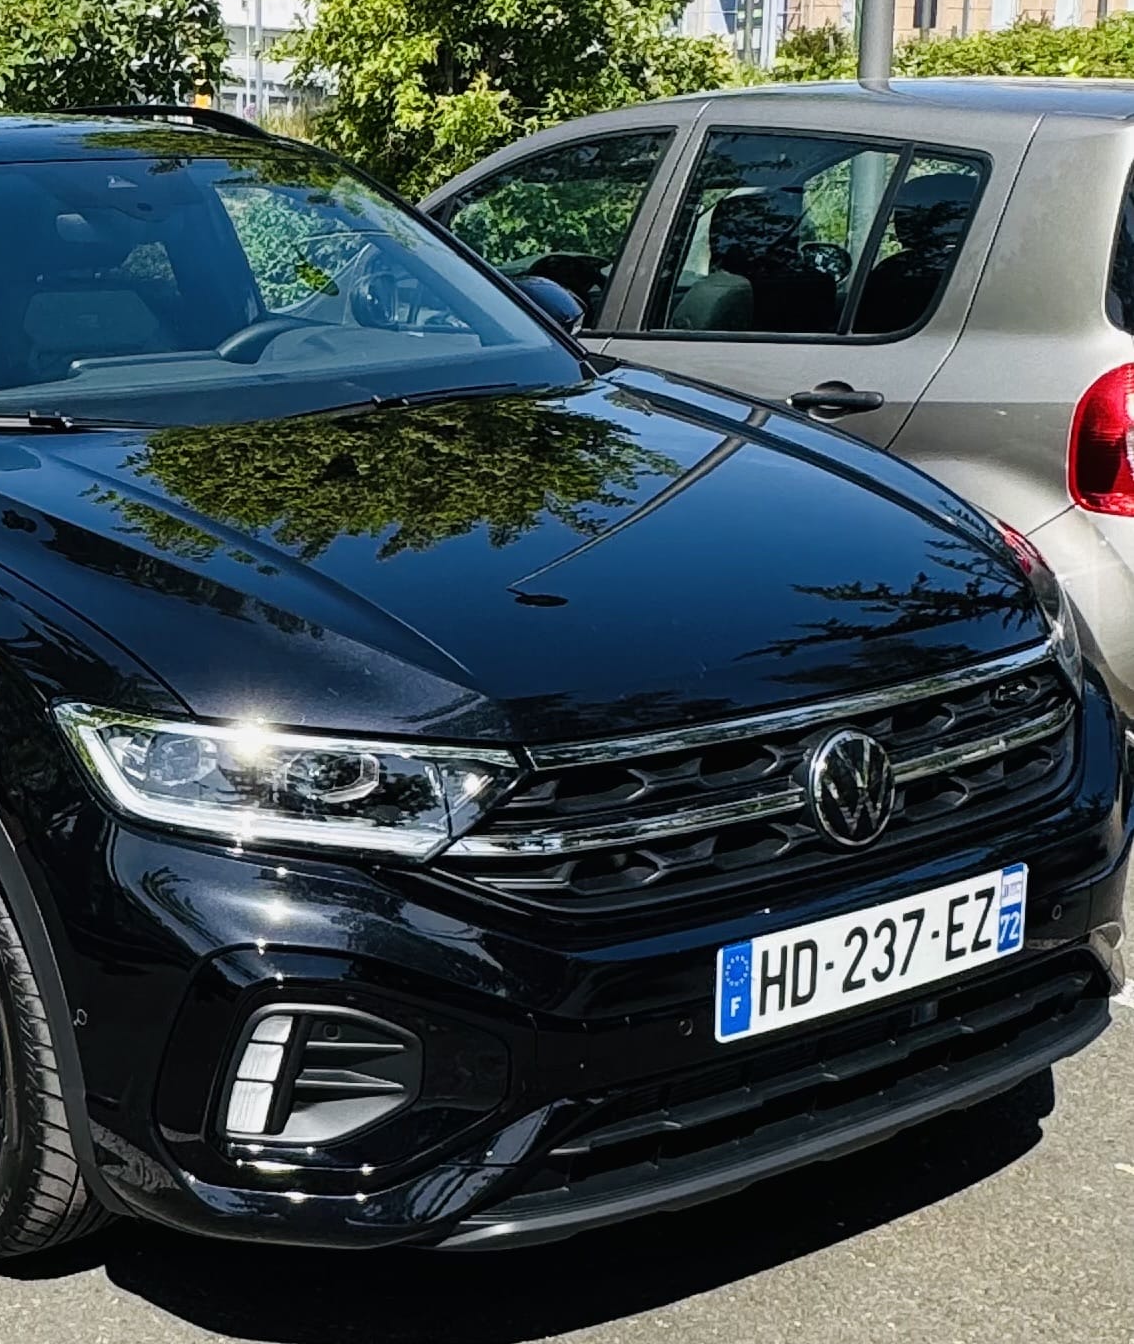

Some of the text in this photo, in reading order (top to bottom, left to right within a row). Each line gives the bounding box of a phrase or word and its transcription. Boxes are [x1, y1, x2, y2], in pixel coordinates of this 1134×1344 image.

[730, 997, 742, 1017] F
[759, 887, 995, 1016] HD-237-EZ
[999, 911, 1020, 944] 72
